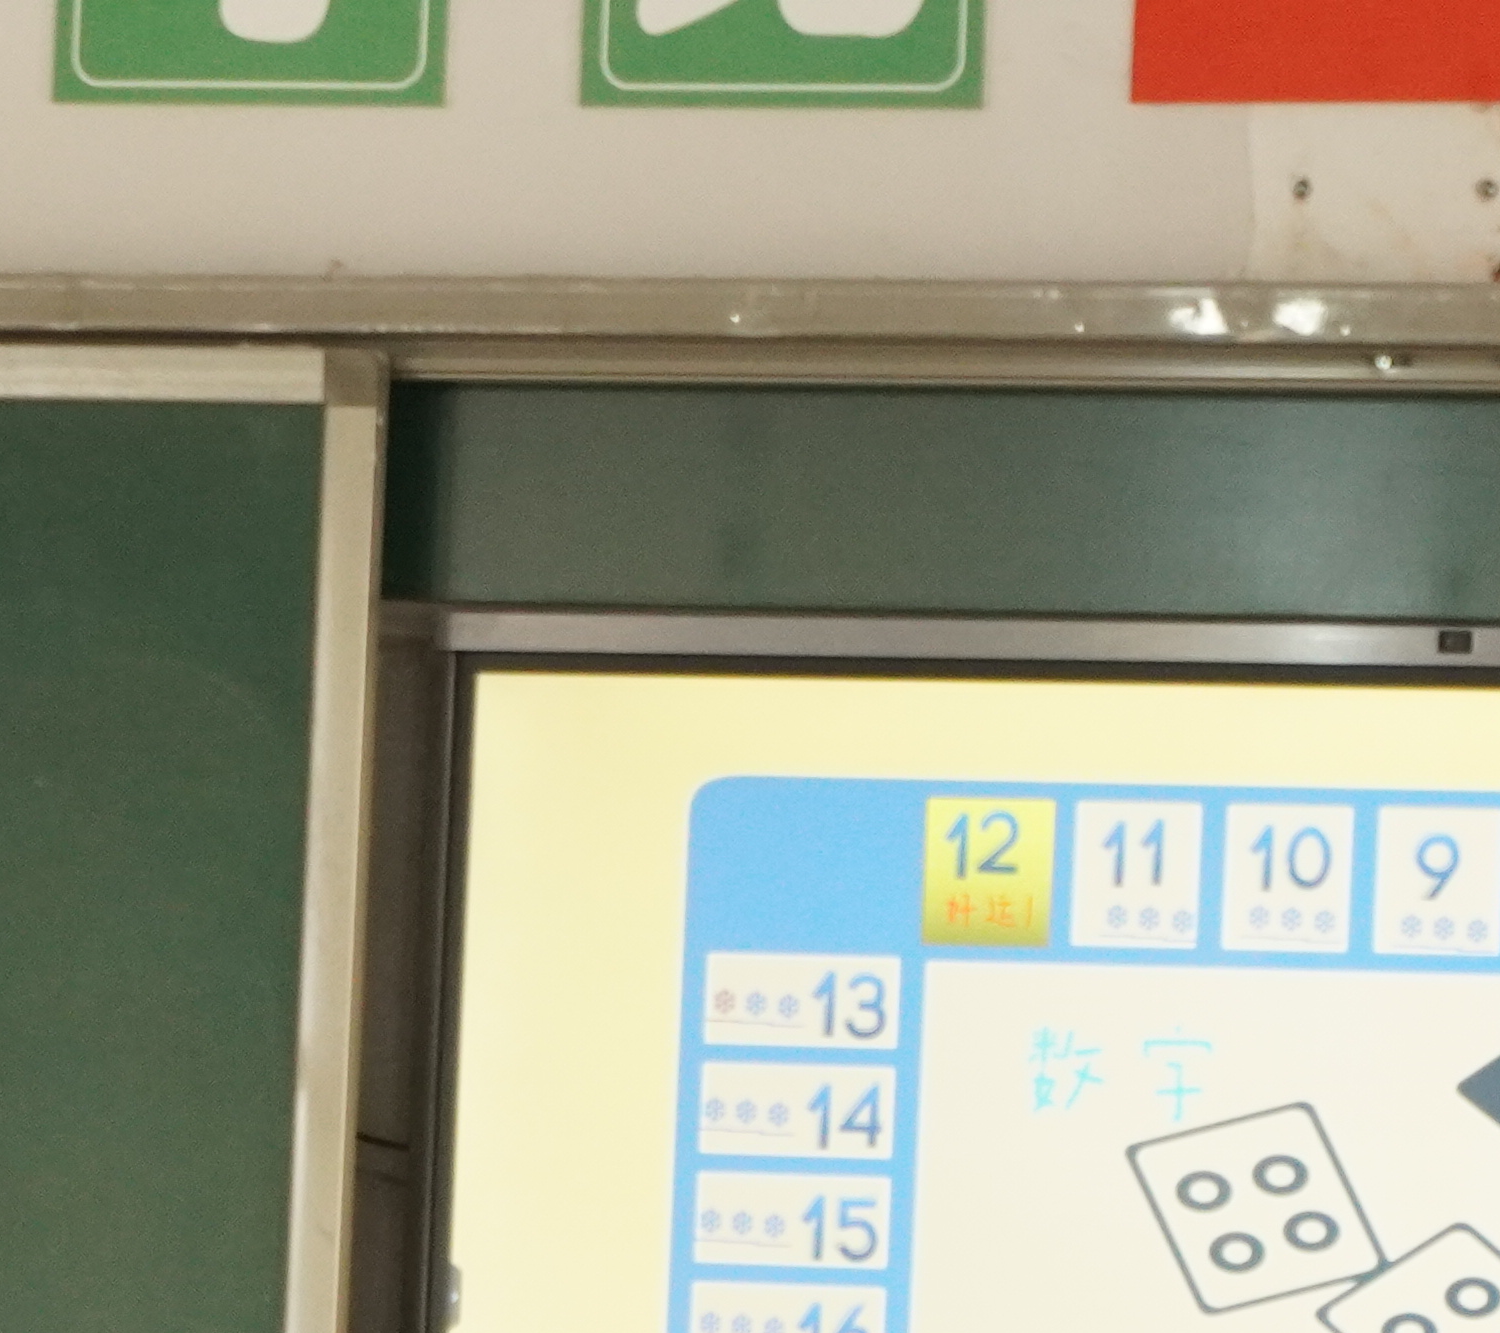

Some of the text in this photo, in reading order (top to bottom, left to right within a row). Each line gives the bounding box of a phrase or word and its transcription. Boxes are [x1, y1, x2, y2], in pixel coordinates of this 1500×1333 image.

[947, 811, 1019, 878] 12
[1104, 819, 1165, 886] 11
[1252, 826, 1332, 890] 10
[1416, 834, 1460, 899] 9
[814, 972, 886, 1039] 13
[1028, 1026, 1213, 1122] 数字
[809, 1085, 881, 1148] 14
[803, 1196, 878, 1262] 15
